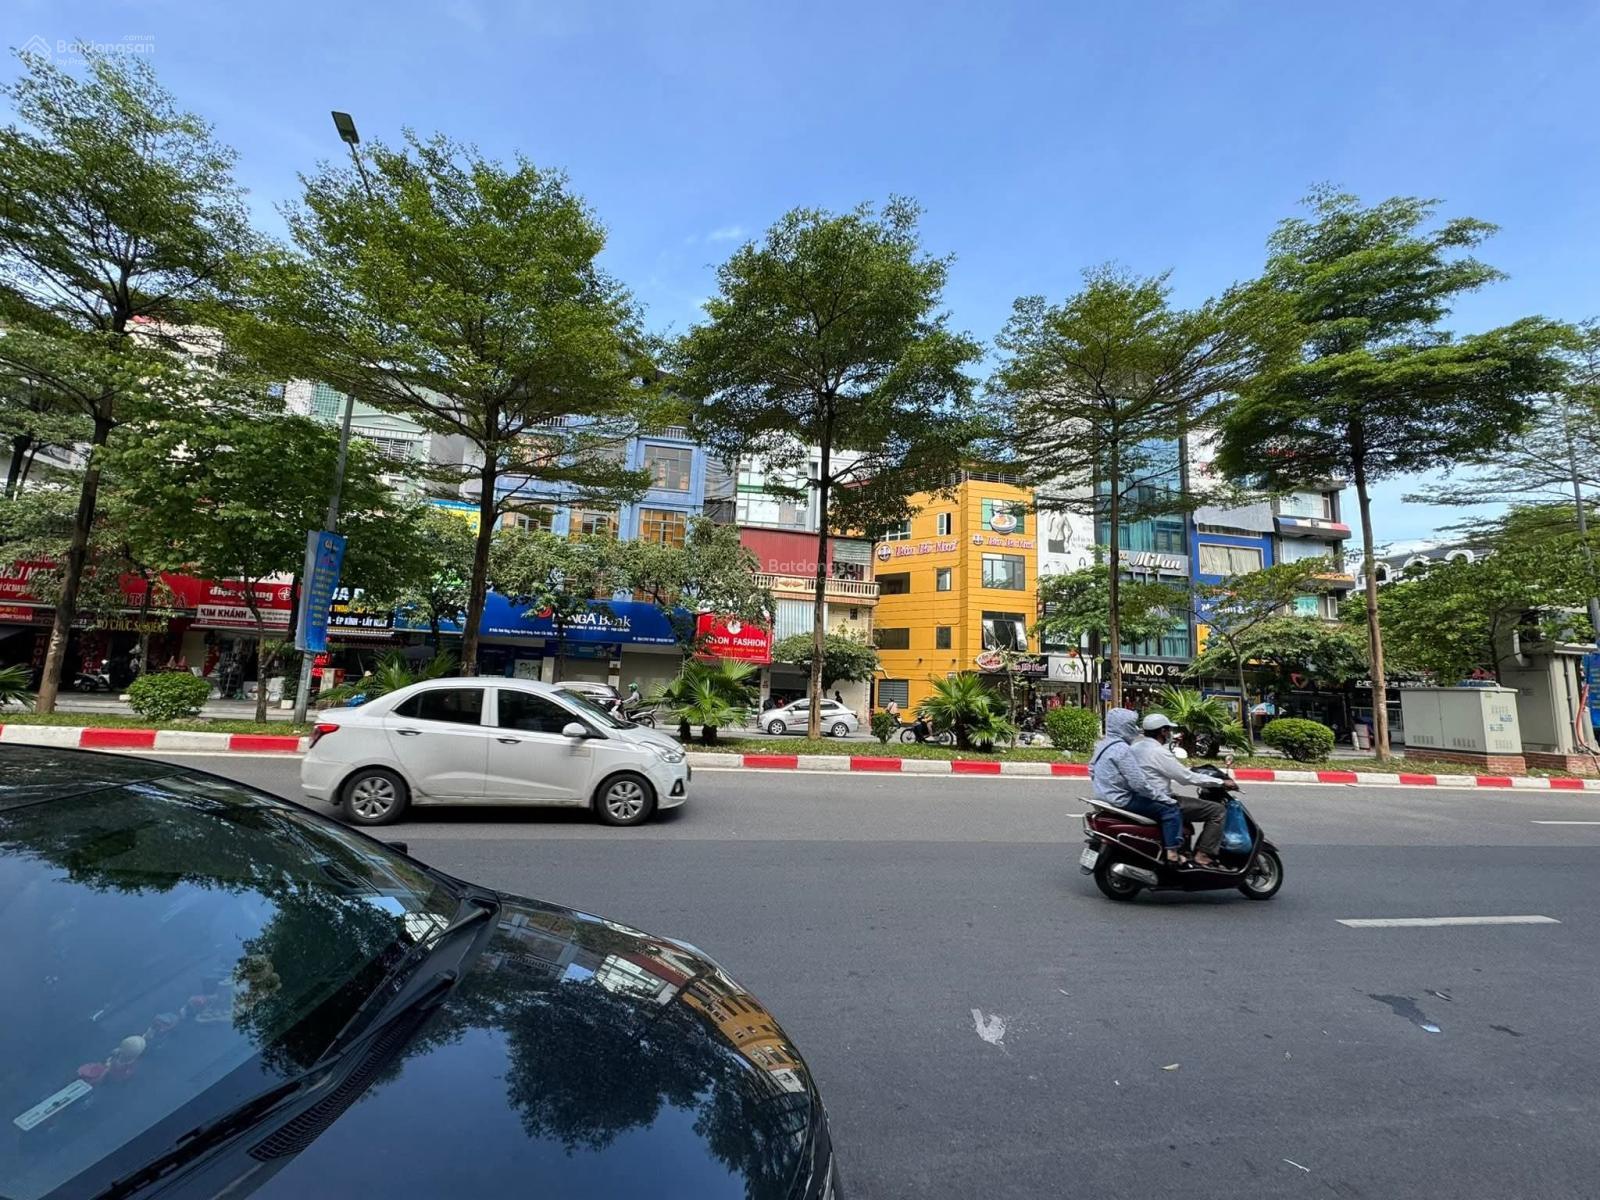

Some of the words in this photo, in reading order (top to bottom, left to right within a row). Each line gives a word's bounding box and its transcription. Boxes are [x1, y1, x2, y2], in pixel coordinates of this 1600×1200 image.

[201, 607, 216, 616] KIM
[219, 607, 247, 618] KHÁNH
[733, 637, 767, 647] FASHION
[1119, 663, 1164, 676] MILANO
